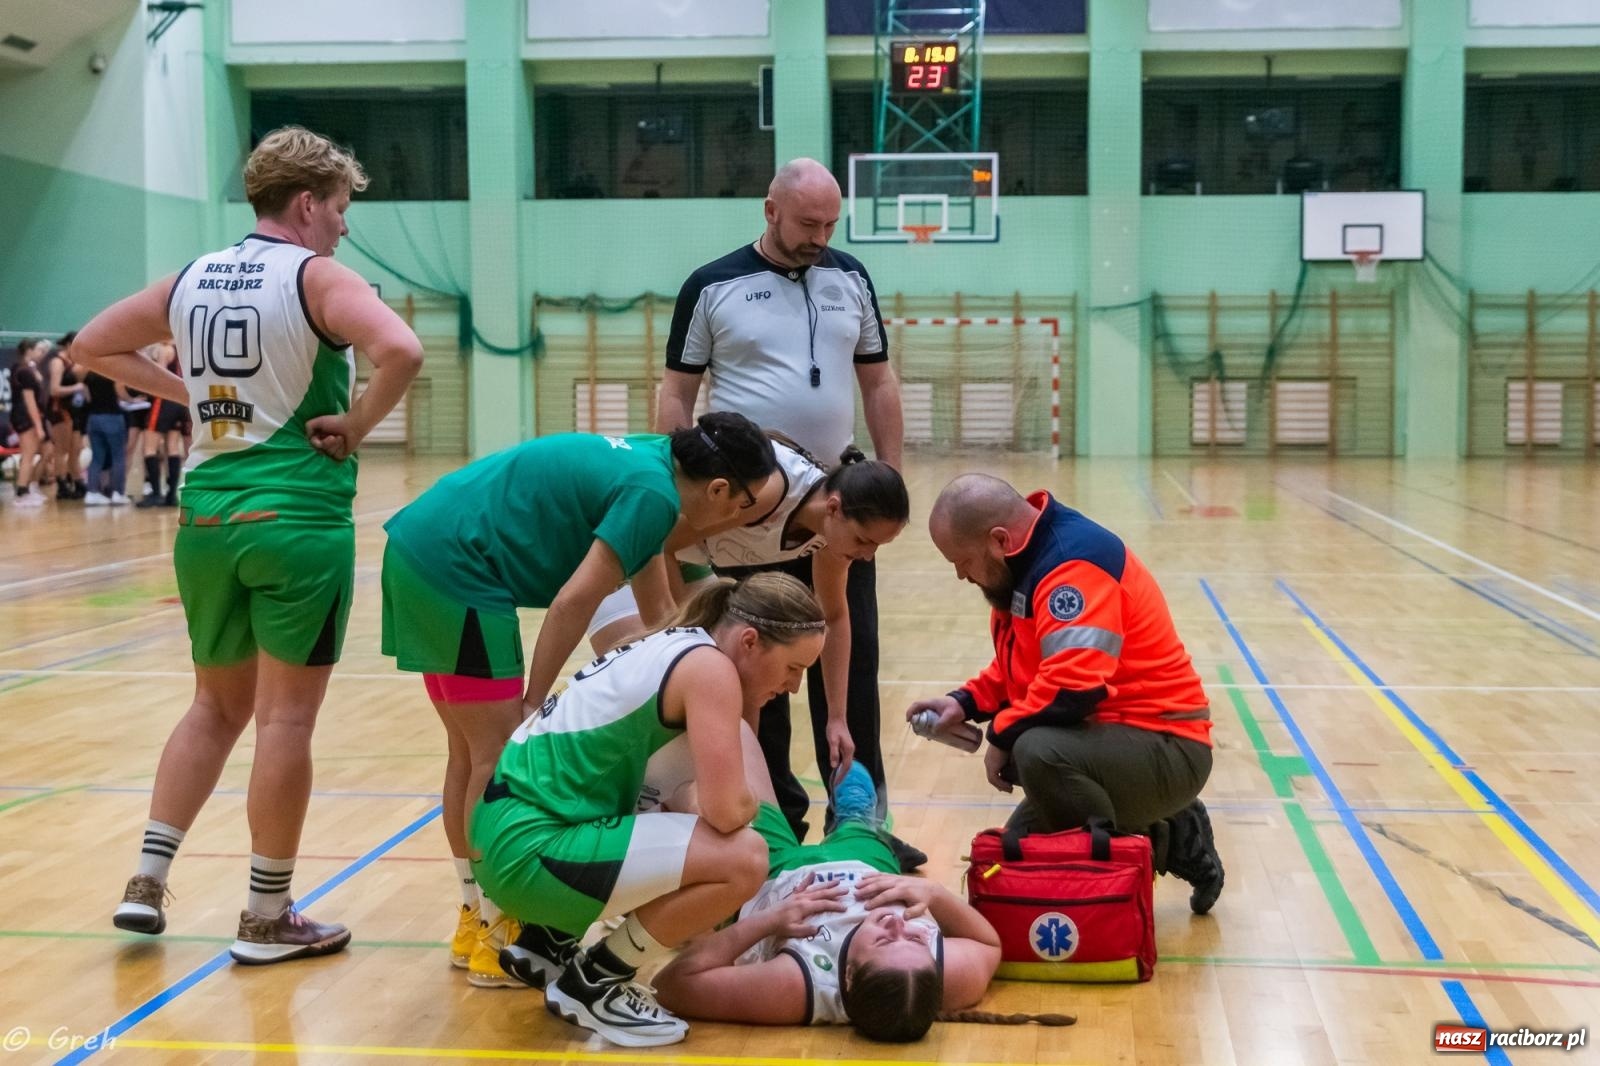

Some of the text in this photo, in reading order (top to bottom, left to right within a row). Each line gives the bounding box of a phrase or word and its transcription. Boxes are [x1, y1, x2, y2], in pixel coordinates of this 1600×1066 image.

[907, 65, 942, 89] 23
[205, 261, 266, 274] RKK AZS
[190, 305, 262, 378] 10
[200, 402, 250, 419] SEGET
